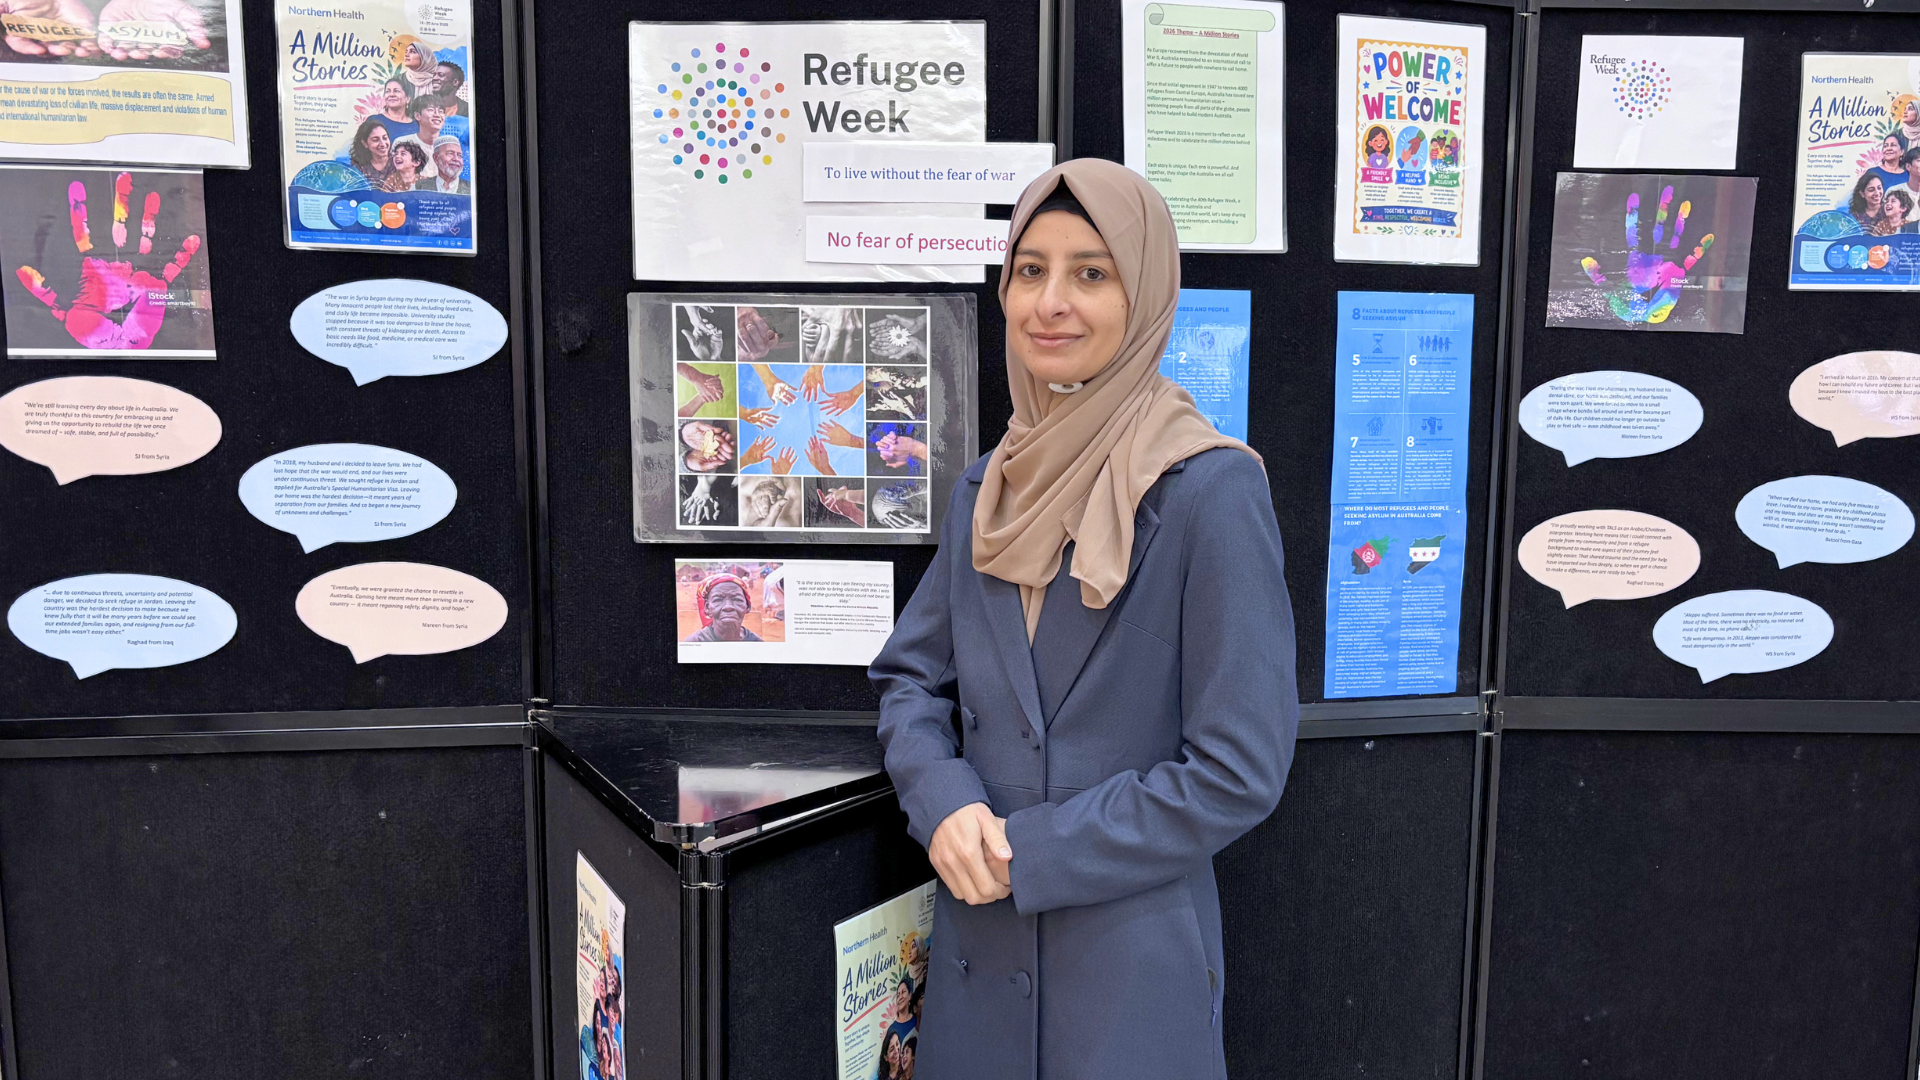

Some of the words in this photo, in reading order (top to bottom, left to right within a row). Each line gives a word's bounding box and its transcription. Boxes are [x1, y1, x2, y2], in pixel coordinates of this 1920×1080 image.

[289, 6, 332, 17] Northern
[334, 10, 364, 20] Health
[6, 22, 86, 36] REFUGEE
[108, 27, 181, 40] ASYLUM
[289, 29, 306, 55] A
[313, 32, 385, 59] Million
[293, 57, 368, 82] Stories
[1373, 51, 1451, 85] POWER
[1590, 54, 1626, 65] Refugee
[803, 53, 965, 92] Refugee
[1595, 65, 1619, 75] Week
[32, 86, 38, 94] of
[57, 87, 66, 95] the
[67, 86, 85, 95] forces
[85, 88, 110, 97] involved,
[112, 89, 120, 97] the
[122, 90, 141, 98] results
[152, 90, 166, 99] often
[167, 92, 176, 100] the
[196, 93, 214, 101] Armed
[1406, 81, 1420, 94] OF
[802, 100, 910, 133] Week
[1363, 92, 1461, 125] WELCOME
[1809, 96, 1822, 118] A
[1827, 96, 1886, 120] Million
[1808, 120, 1871, 143] Stories
[824, 167, 840, 178] To
[844, 167, 866, 178] live
[870, 168, 920, 179] without
[923, 168, 943, 180] the
[947, 168, 971, 180] fear
[975, 168, 988, 180] of
[828, 232, 850, 247] No
[856, 232, 890, 247] fear
[896, 233, 913, 248] of
[918, 235, 1008, 254] persecutio
[325, 318, 347, 326] stopped
[1352, 308, 1361, 320] 8
[1178, 352, 1186, 363] 2
[1352, 354, 1360, 365] 5
[1409, 354, 1417, 366] 6
[1351, 437, 1358, 448] 7
[1407, 436, 1414, 447] 8
[580, 901, 583, 924] A
[584, 908, 600, 945] Million
[580, 926, 596, 962] Stories
[843, 937, 869, 956] Northern
[870, 927, 888, 943] Health
[843, 967, 852, 996] A
[856, 951, 898, 986] Million
[843, 977, 888, 1023] Stories
